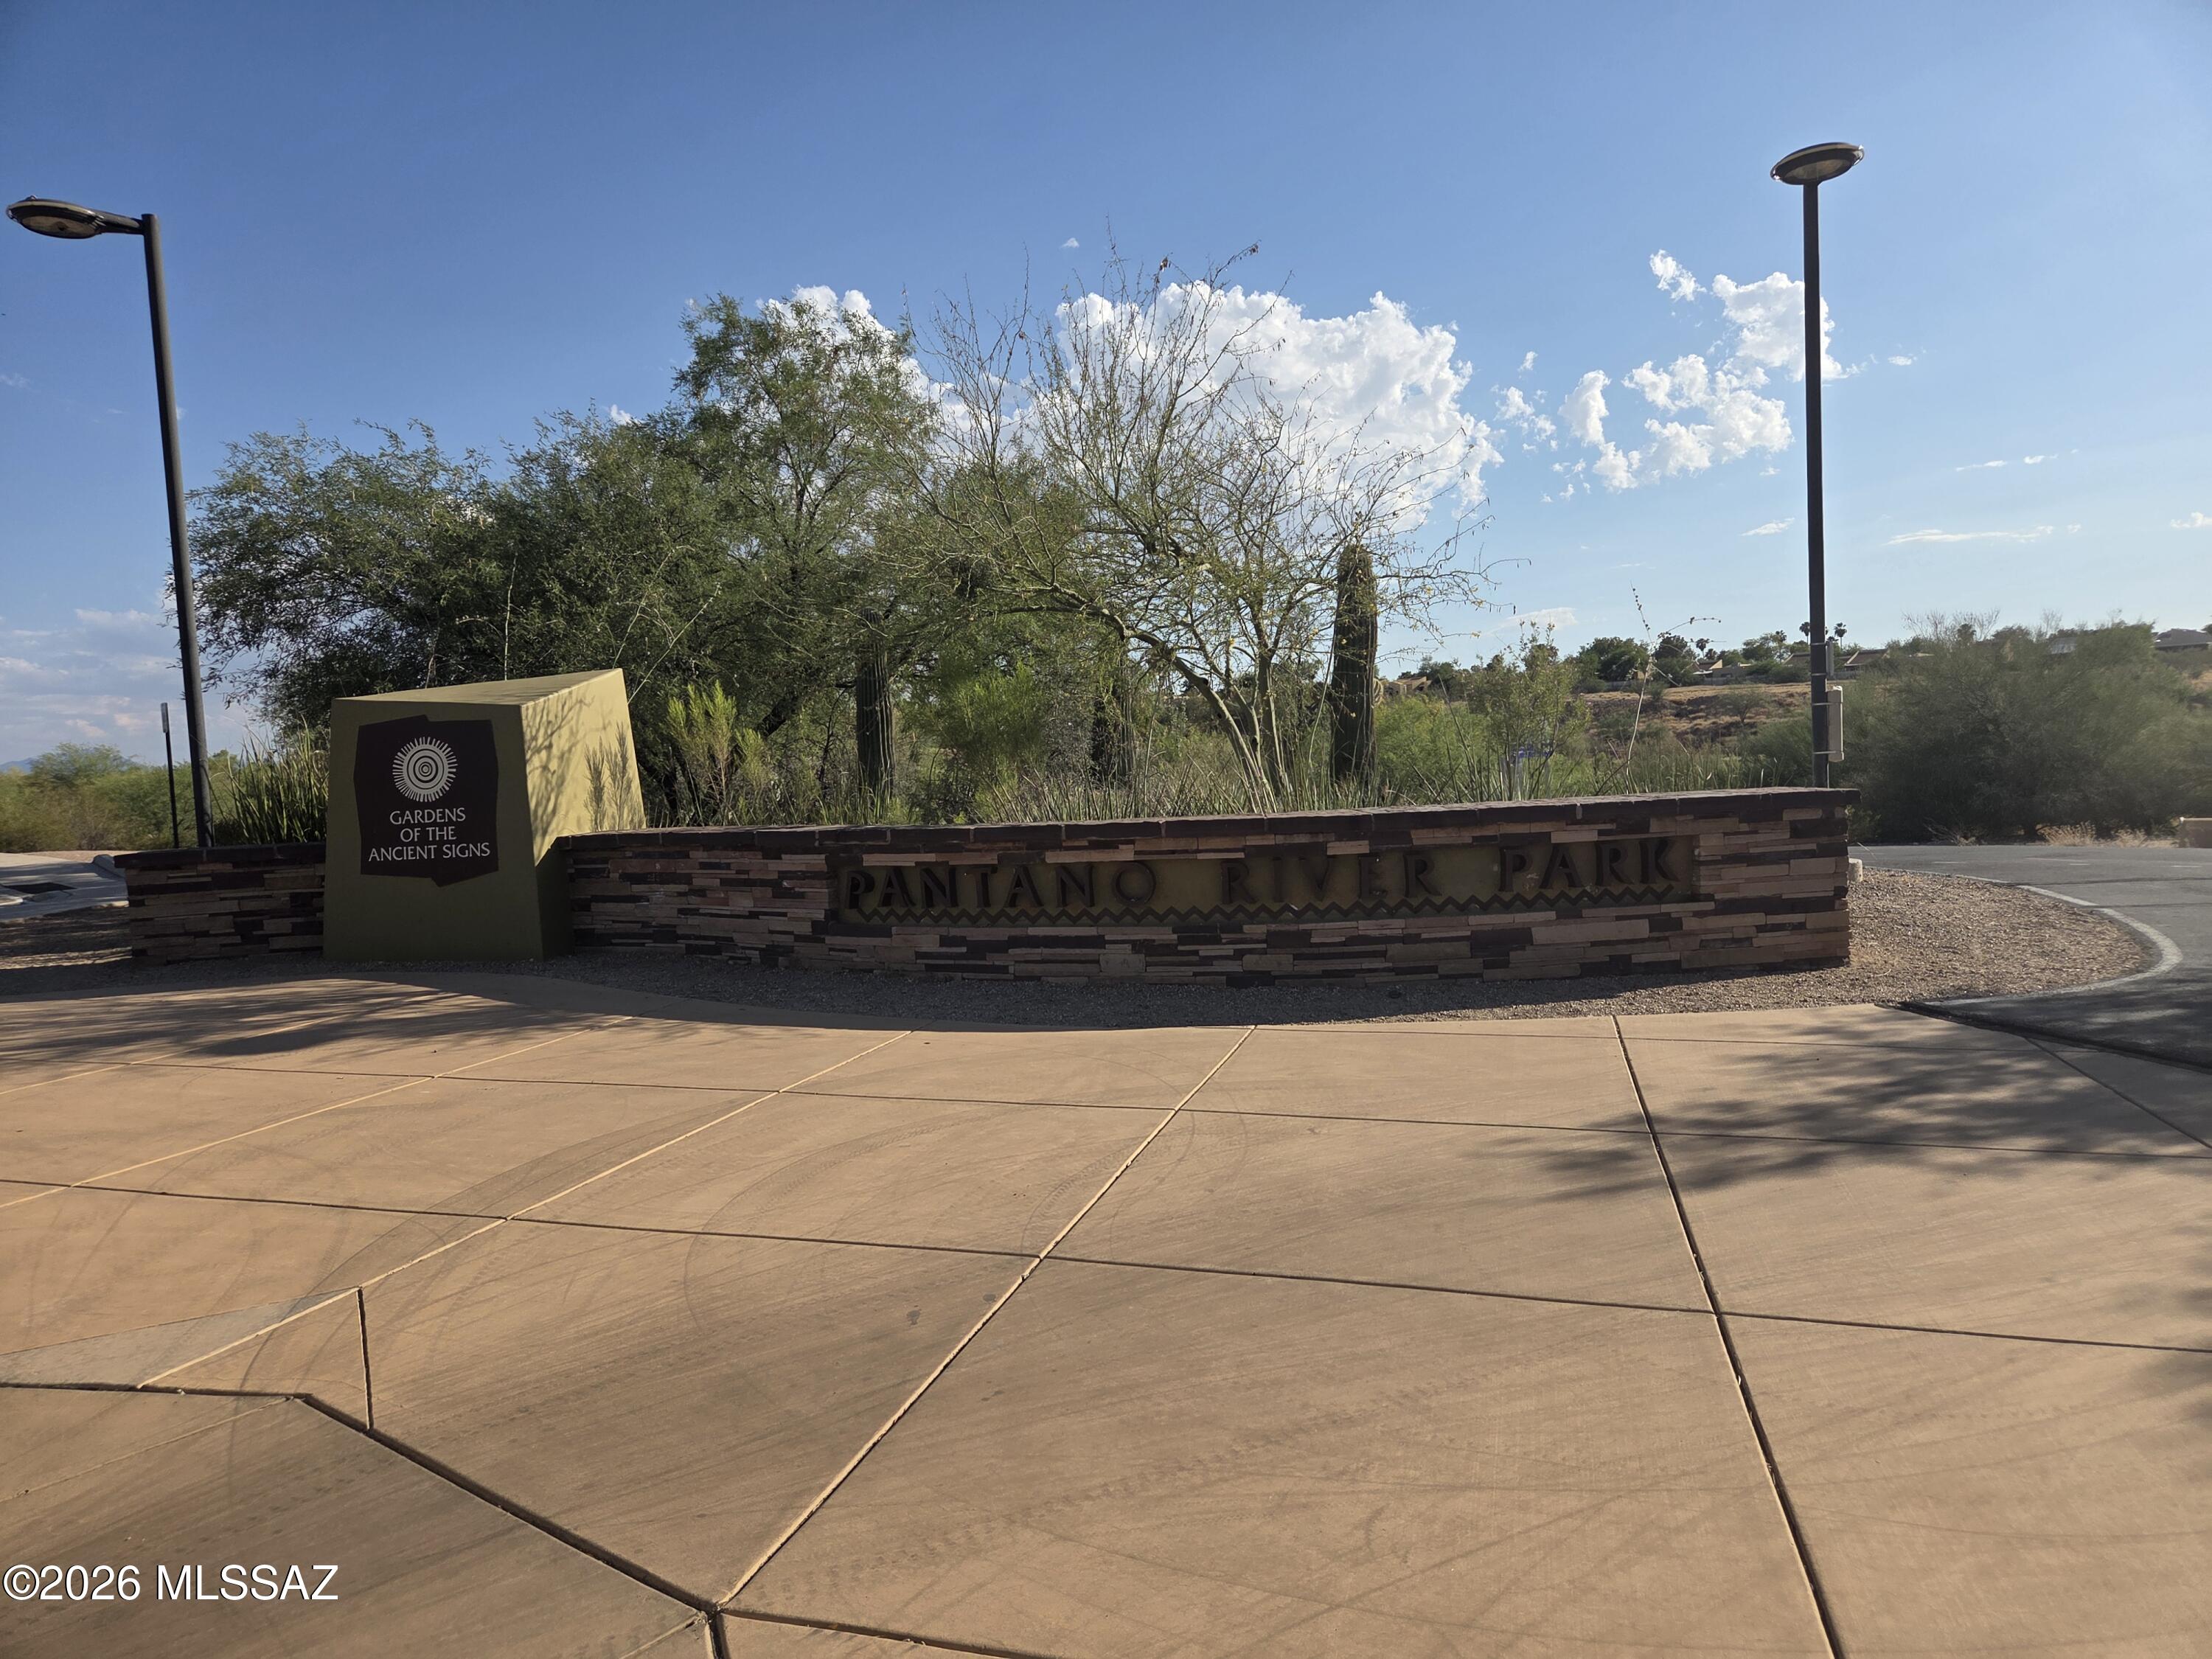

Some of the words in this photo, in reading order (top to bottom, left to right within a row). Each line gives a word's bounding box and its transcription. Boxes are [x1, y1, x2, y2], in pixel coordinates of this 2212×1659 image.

[389, 807, 466, 824] GARDENS
[400, 827, 421, 842] OF
[426, 826, 456, 841] THE
[369, 845, 437, 861] ANCIENT
[442, 843, 490, 858] SIGNS
[844, 861, 1158, 910] PANTANO
[1220, 851, 1442, 905] RIVER
[1498, 839, 1681, 892] PARK
